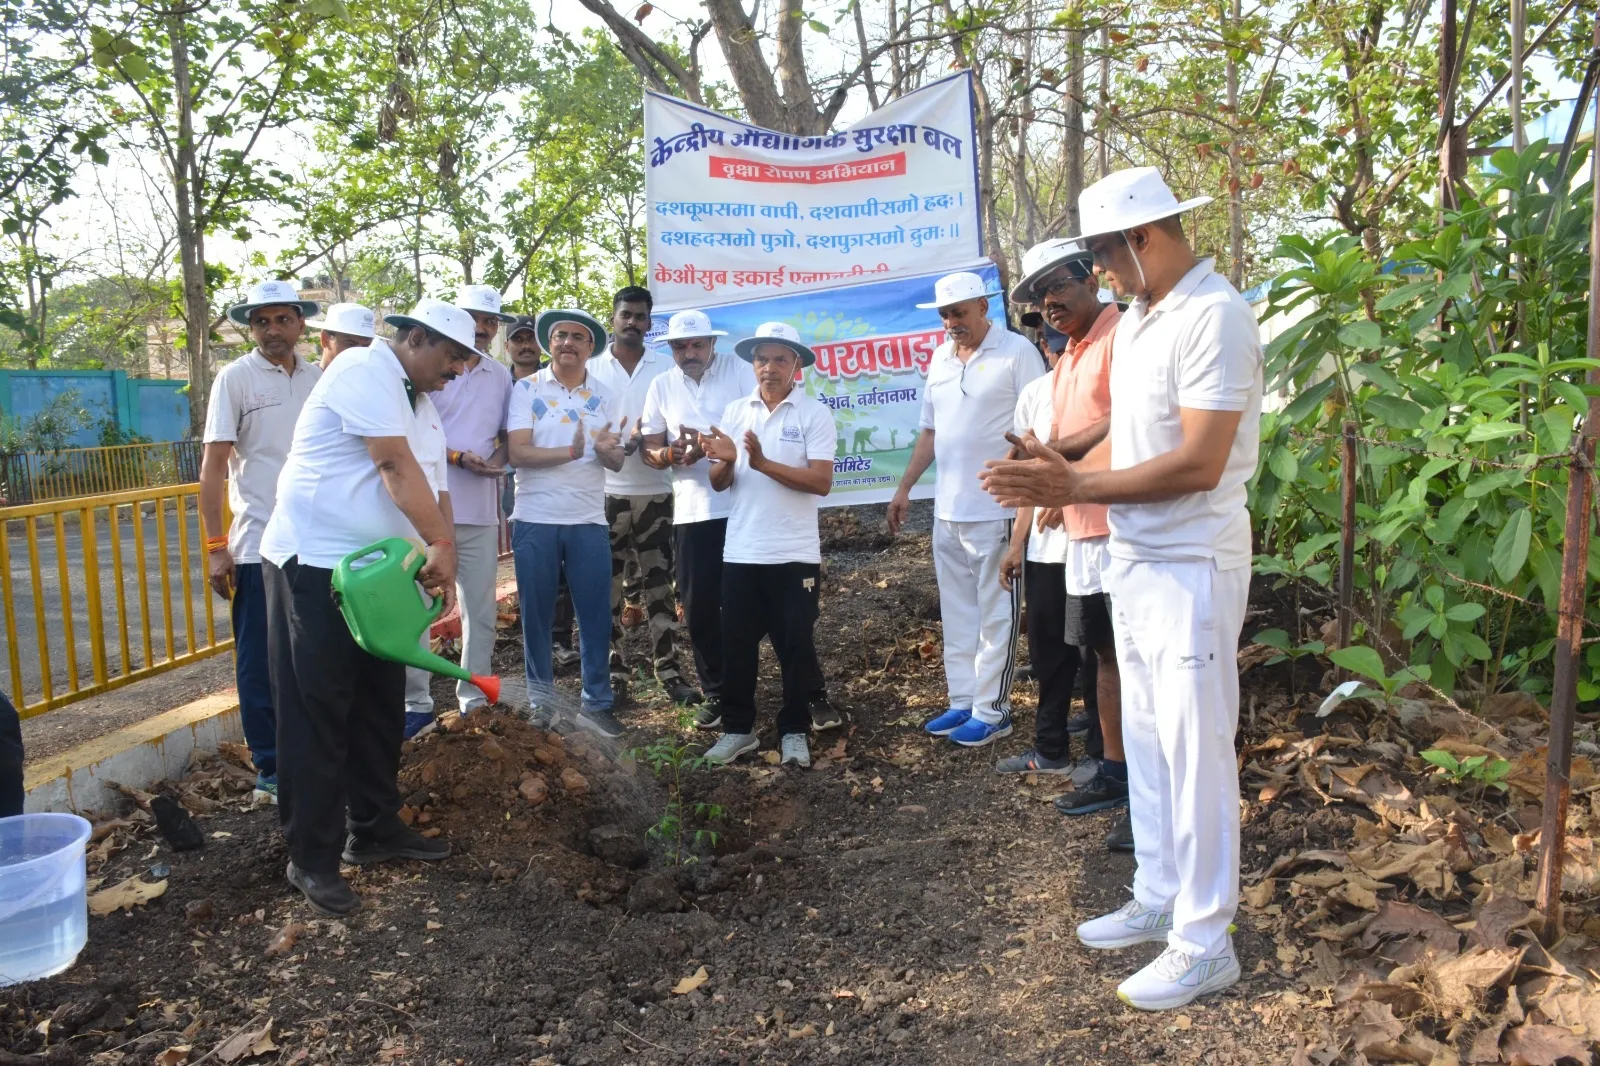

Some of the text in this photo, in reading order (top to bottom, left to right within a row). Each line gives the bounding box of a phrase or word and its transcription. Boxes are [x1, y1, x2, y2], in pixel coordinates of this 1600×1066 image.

[650, 122, 724, 168] केन्द्रीय
[852, 123, 918, 153] सुरक्षा
[921, 126, 962, 160] बल
[764, 164, 811, 180] रोपण
[815, 159, 896, 181] अभियान
[655, 201, 755, 222] दशकूपसमा
[760, 201, 804, 221] वापी,
[809, 193, 919, 221] दशवापीसमो
[761, 229, 801, 253] पुत्रो,
[806, 225, 905, 254] दशपुत्रसमो
[655, 263, 728, 291] केऔसुब
[732, 265, 787, 287] इकाई
[857, 386, 918, 407] नर्मदानगर
